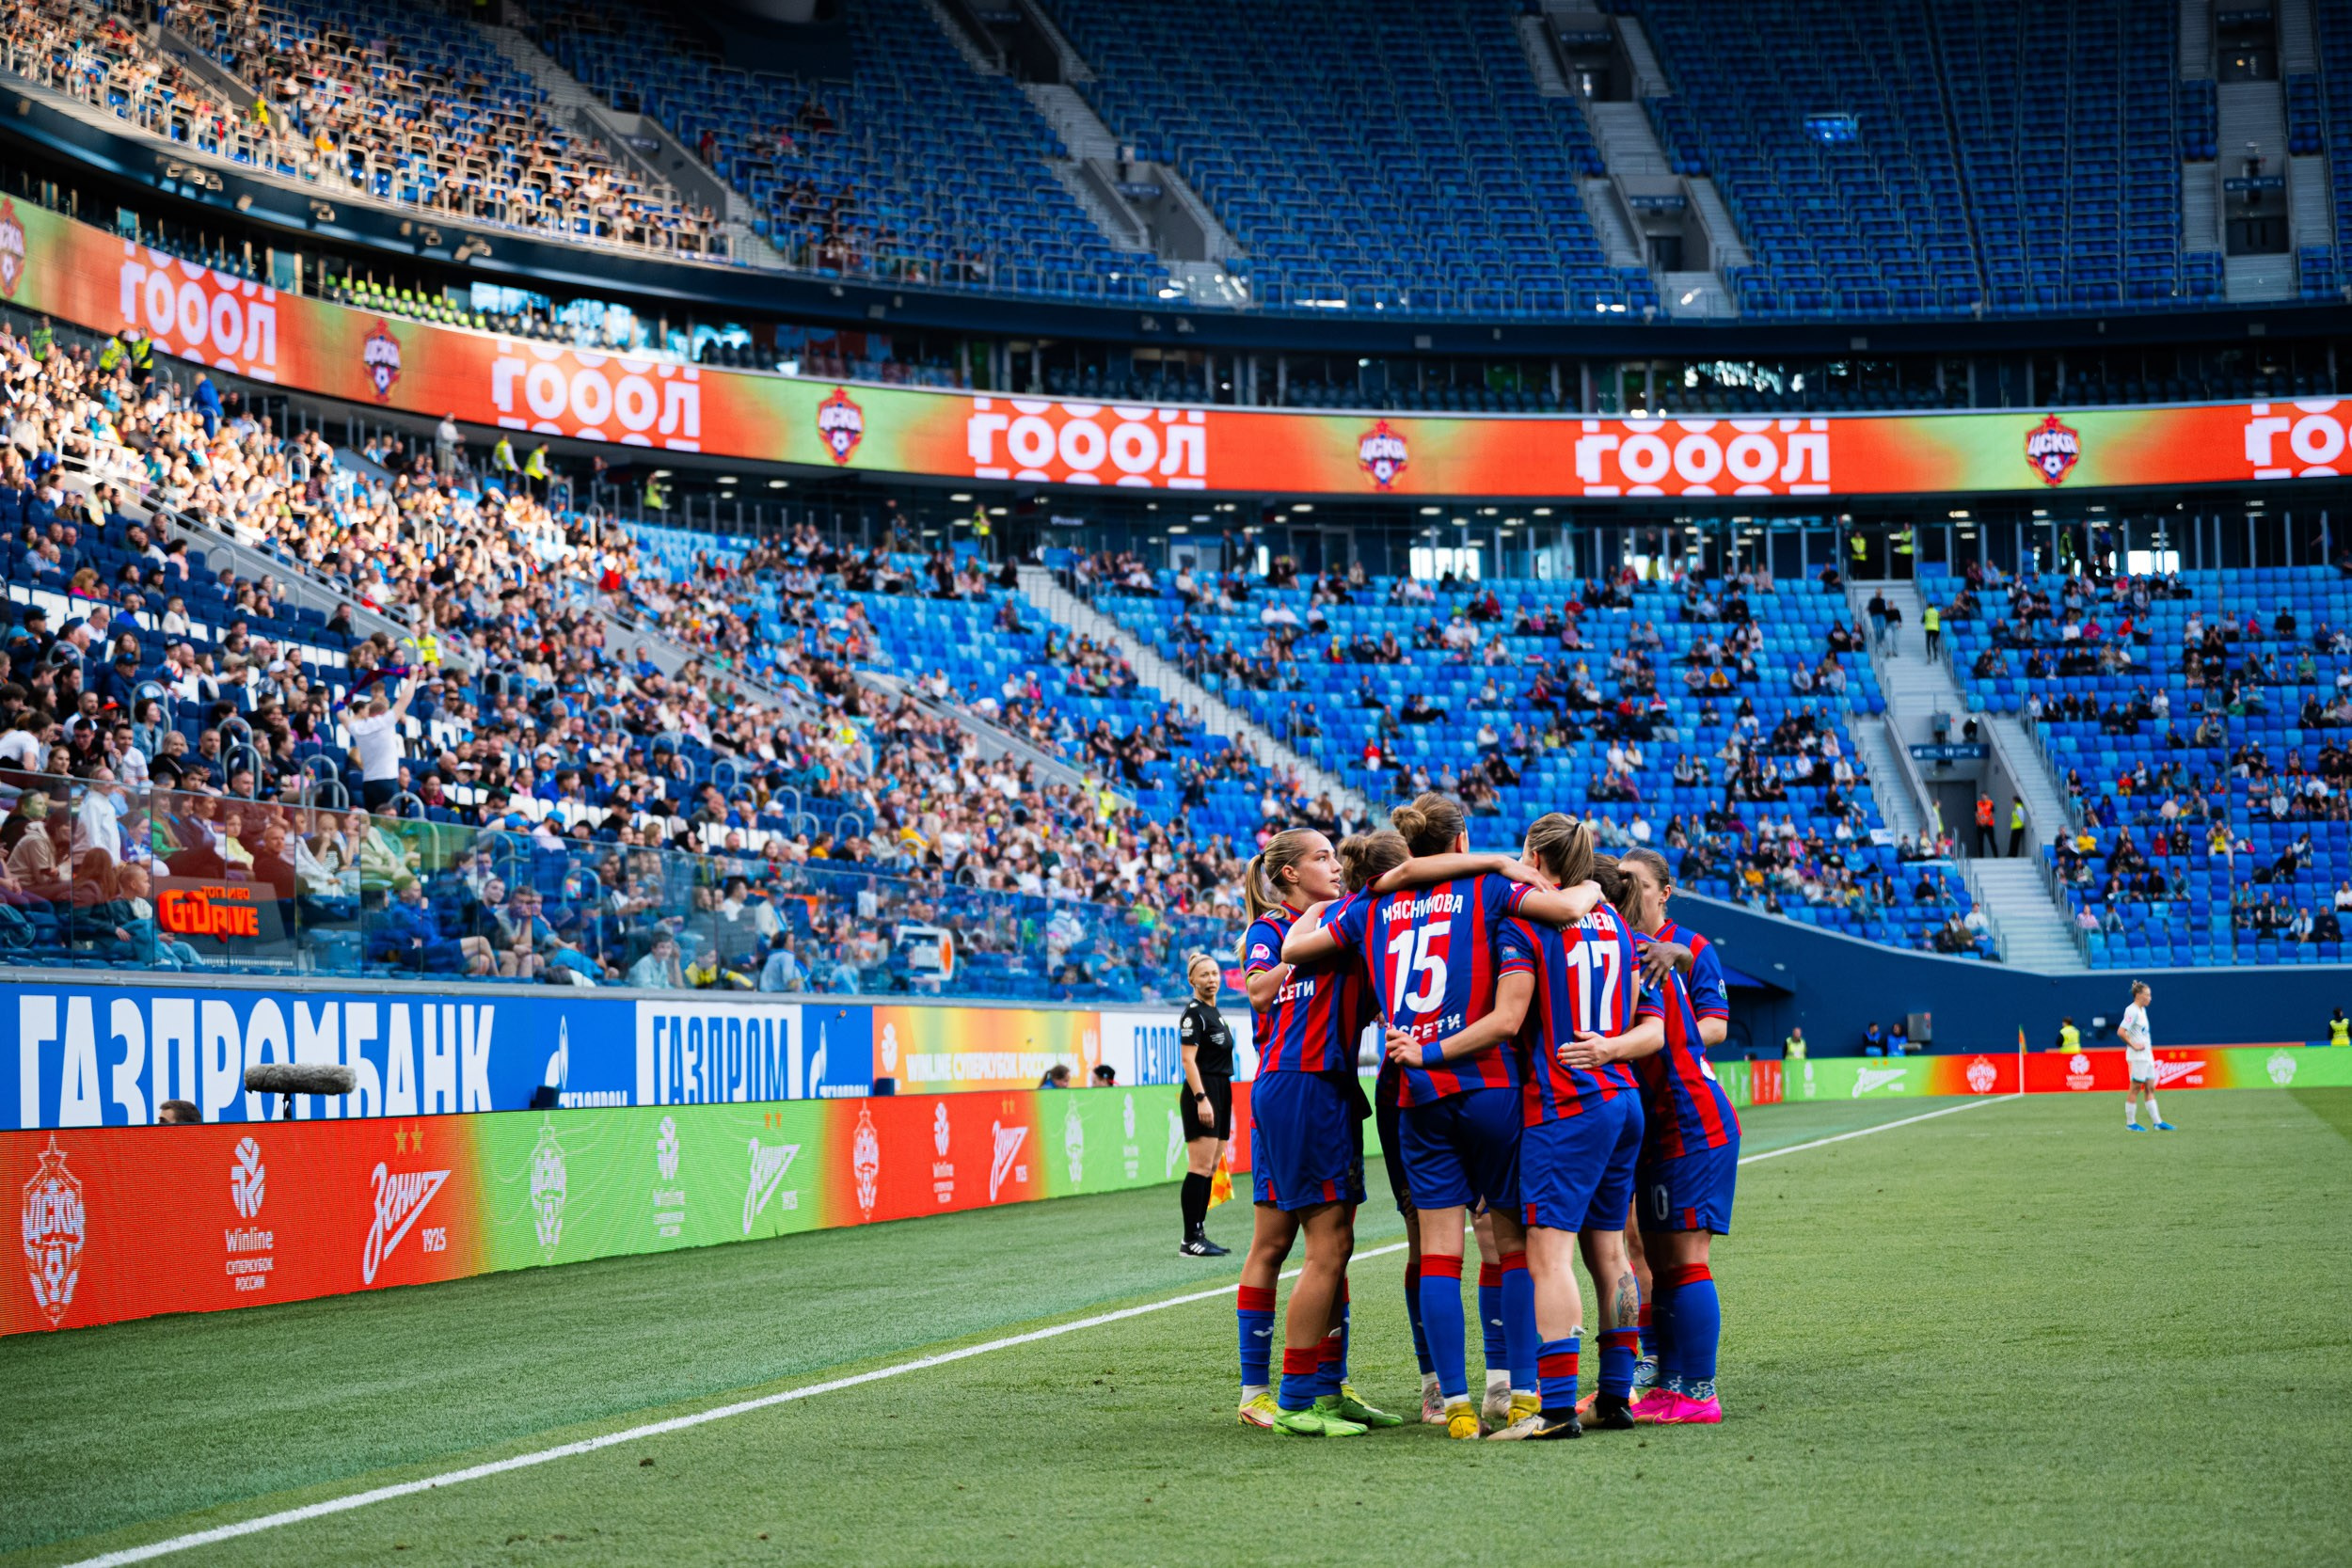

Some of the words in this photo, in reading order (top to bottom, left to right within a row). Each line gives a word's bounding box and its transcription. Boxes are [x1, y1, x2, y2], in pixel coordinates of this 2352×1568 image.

[120, 260, 276, 365] ГОООЛ
[492, 356, 700, 437] ГОООЛ
[968, 413, 1206, 476] ГОООЛ
[1575, 433, 1830, 483] ГОООЛ
[2245, 415, 2352, 467] ГО
[1273, 980, 1315, 1005] СЕТИ
[1388, 920, 1452, 1015] 15
[1566, 940, 1621, 1032] 17
[20, 995, 495, 1129] ГАЗПРОМБАНК
[653, 1016, 788, 1105] ГАЗПРОМ
[226, 1227, 274, 1252] Winline
[422, 1227, 447, 1252] 1925
